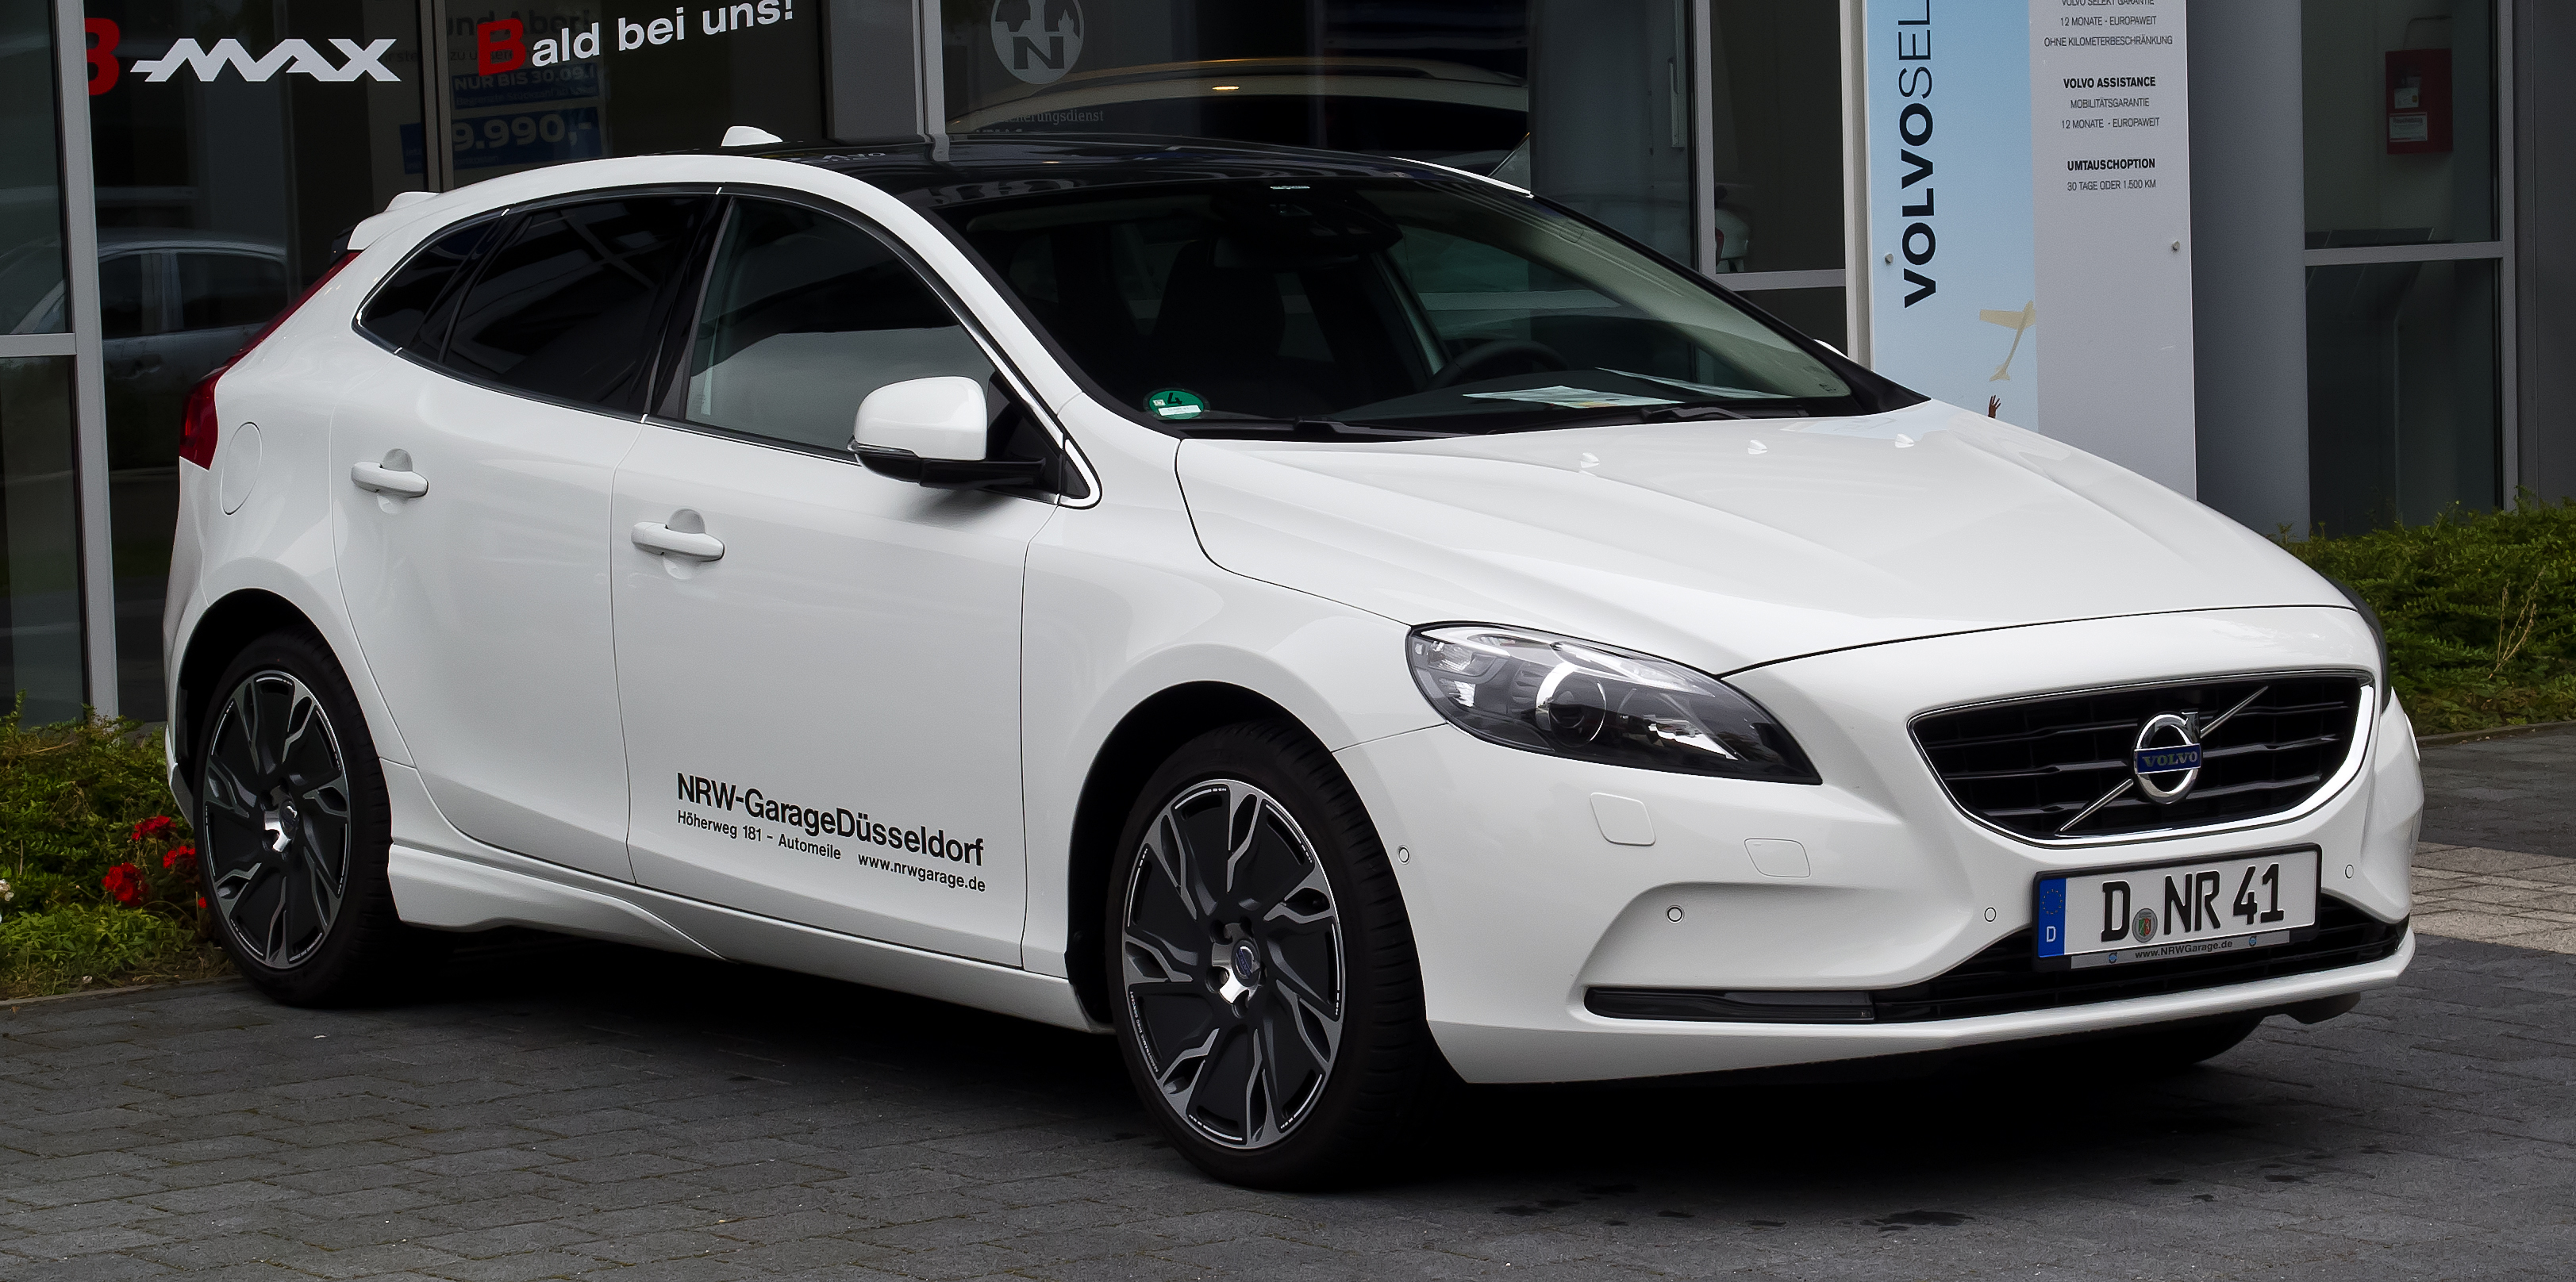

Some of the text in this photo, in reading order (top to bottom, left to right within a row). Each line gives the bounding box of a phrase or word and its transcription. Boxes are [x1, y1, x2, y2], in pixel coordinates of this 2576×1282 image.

[2060, 17, 2070, 26] 12
[2071, 17, 2103, 26] MONATE
[2109, 16, 2157, 25] EUROPAWEIT
[477, 0, 793, 77] Bald bei uns!
[2043, 34, 2174, 47] OHNE KILOMETERBESCHRÄNKUNG
[2063, 76, 2156, 89] VOLVO ASSISTANCE
[2070, 97, 2150, 109] MOBILITÄTSGARANTIE
[2062, 119, 2070, 129] 12
[2072, 118, 2105, 129] MONATE
[2113, 117, 2160, 128] EUROPAWEIT
[2067, 158, 2156, 171] UMTAUSCHOPTION
[2067, 181, 2078, 191] 30
[2078, 181, 2098, 190] TAGE
[2099, 180, 2121, 190] ODER
[2144, 179, 2156, 189] KM
[1167, 392, 1182, 405] 4
[2142, 750, 2198, 767] VOLVO
[677, 772, 985, 867] NRW-GarageDüsseldorf
[677, 809, 738, 839] Höherweg
[742, 824, 763, 843] 181
[778, 833, 841, 861] Automeile
[858, 854, 986, 892] www.nrwgarage.de
[2101, 881, 2131, 942] D
[2163, 870, 2220, 935] NR
[2232, 863, 2285, 926] 41
[2046, 925, 2057, 942] D
[2135, 940, 2233, 958] www.NRWGarage.de
